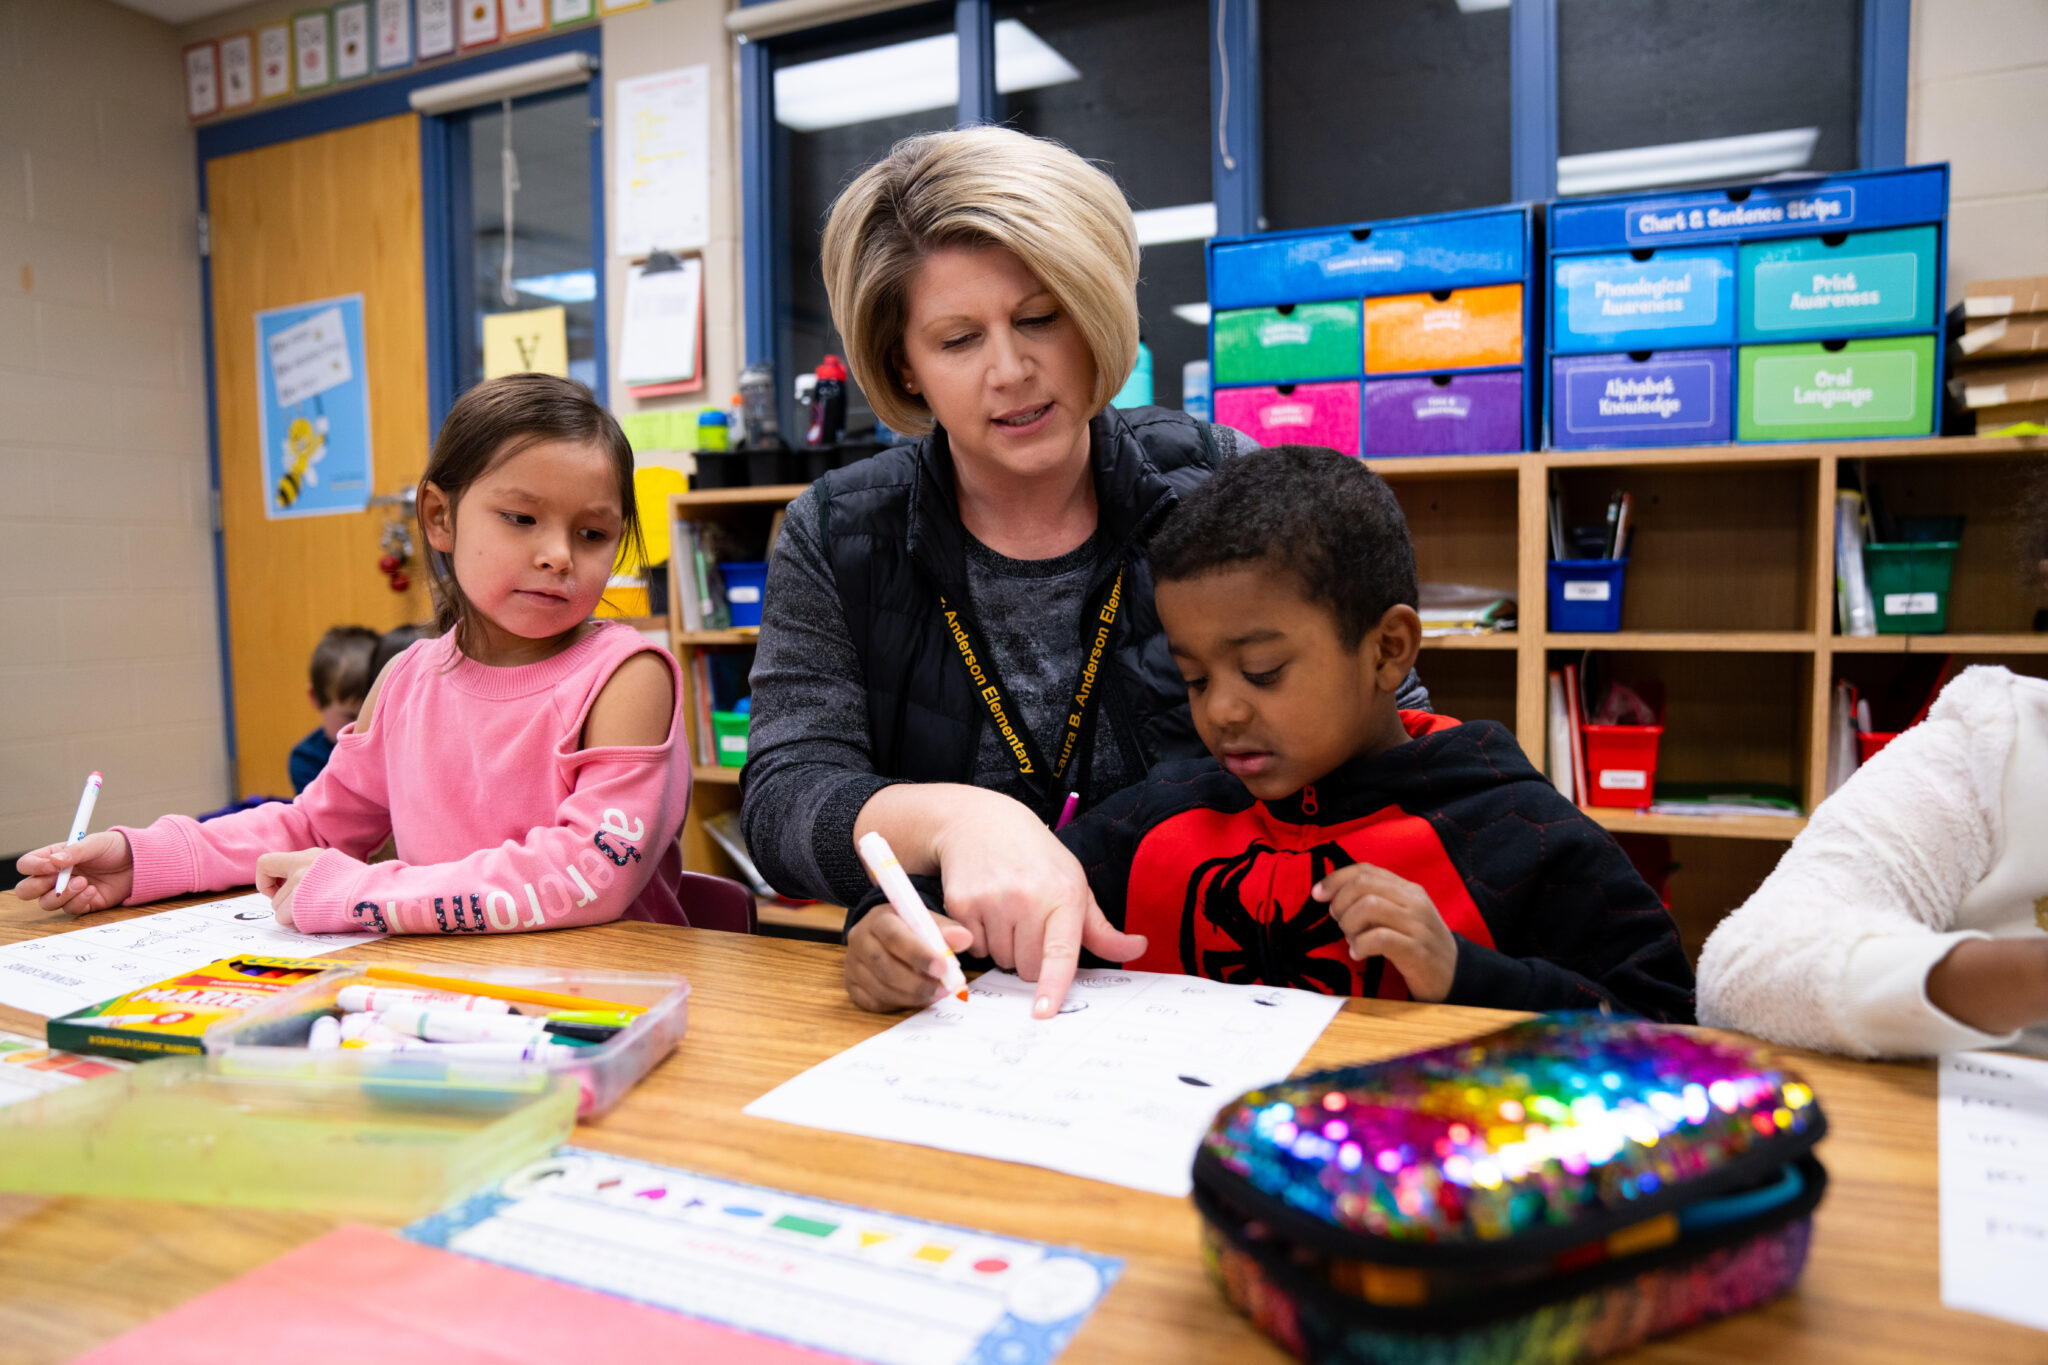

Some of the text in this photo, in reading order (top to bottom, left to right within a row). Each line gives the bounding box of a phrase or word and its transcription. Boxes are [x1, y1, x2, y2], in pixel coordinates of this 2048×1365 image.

[1638, 198, 1842, 234] Chart & Sentence Strips
[1595, 272, 1692, 299] Phonological
[1812, 271, 1858, 294] Print
[1601, 298, 1685, 316] Awareness
[1790, 290, 1880, 310] Awareness
[1604, 376, 1676, 401] Alphabet
[1814, 366, 1854, 388] Oral
[1598, 394, 1682, 418] Knowledge
[1793, 386, 1874, 409] Language
[1074, 626, 1111, 708] Anderson
[944, 610, 1035, 775] Anderson Elementary
[1068, 711, 1084, 730] B.
[1052, 731, 1078, 780] Laura
[129, 987, 266, 1009] MARKE
